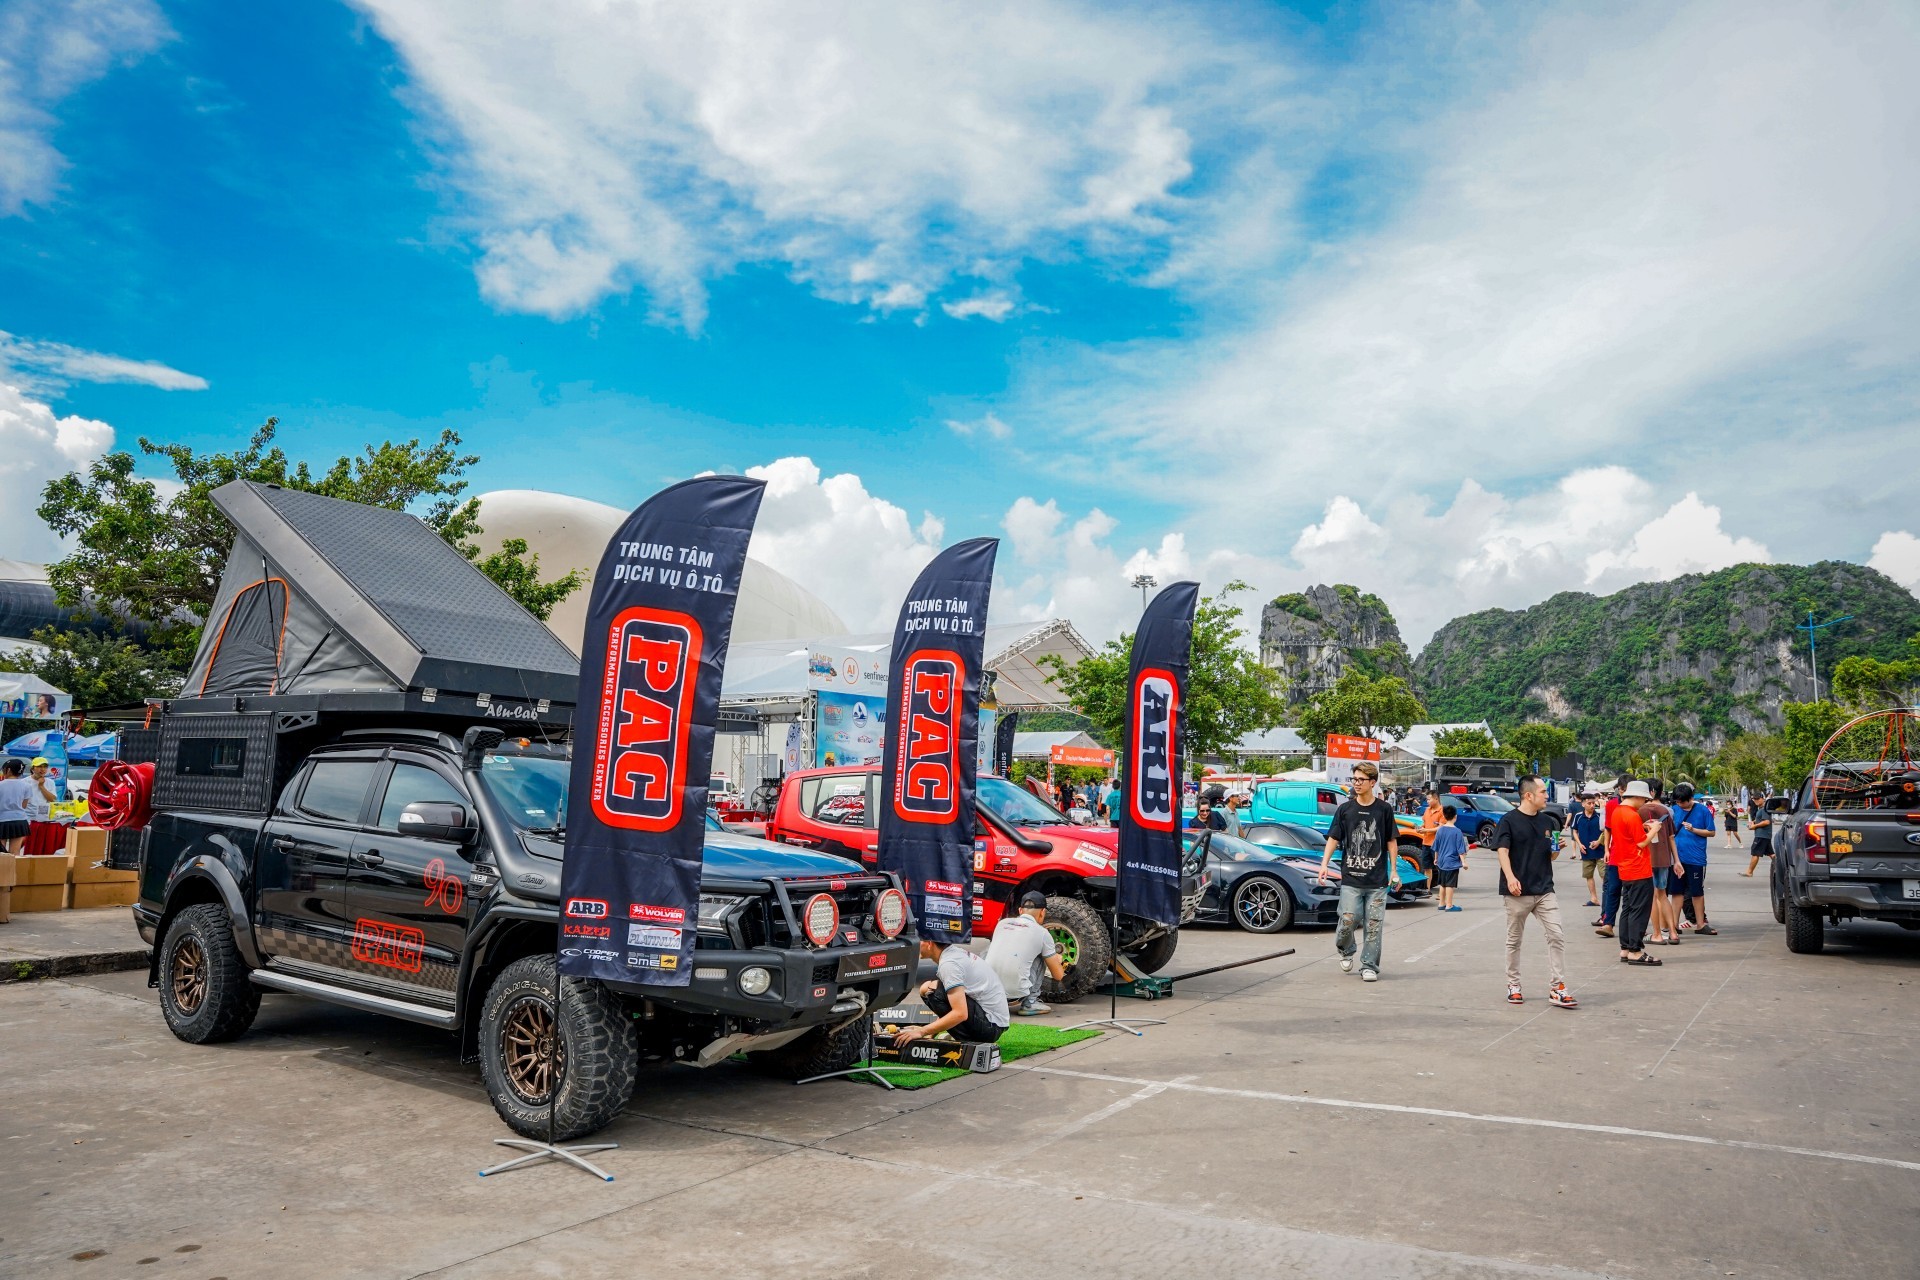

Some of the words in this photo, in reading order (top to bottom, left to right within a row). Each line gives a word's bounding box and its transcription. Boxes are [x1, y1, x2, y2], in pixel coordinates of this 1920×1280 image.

[620, 541, 674, 562] TRUNG
[679, 546, 714, 568] TÂM
[613, 564, 654, 584] DỊCH
[659, 568, 682, 590] VỤ
[685, 568, 698, 589] Ô
[702, 573, 723, 594] TÔ
[908, 598, 943, 614] TRUNG
[945, 597, 968, 614] TÂM
[905, 617, 931, 634] DỊCH
[933, 617, 949, 634] VỤ
[951, 616, 959, 632] Ô
[961, 617, 974, 633] TÔ
[605, 626, 620, 695] PERFORMANCE
[901, 667, 911, 721] PERFORMANCE
[484, 703, 538, 720] Alu-Cab
[612, 634, 683, 802] PAC
[597, 698, 612, 761] ACCESSORIES
[907, 672, 951, 801] PAC
[897, 722, 906, 771] ACCESSORIES
[1141, 684, 1170, 814] ARB
[593, 762, 605, 801] CENTER
[894, 773, 902, 803] CENTER
[1126, 861, 1140, 869] 4x4
[1140, 862, 1179, 878] ACCESSORIES
[424, 858, 463, 914] 90
[570, 902, 605, 915] ARB
[645, 907, 683, 919] WOLVER
[358, 922, 418, 969] PAC
[583, 948, 620, 958] COOPER
[629, 933, 681, 948] PLATINUM
[588, 954, 613, 962] TIRES
[627, 957, 660, 967] OME
[488, 980, 556, 1021] WRANGLER
[880, 1009, 907, 1019] OME
[911, 1046, 940, 1060] OME
